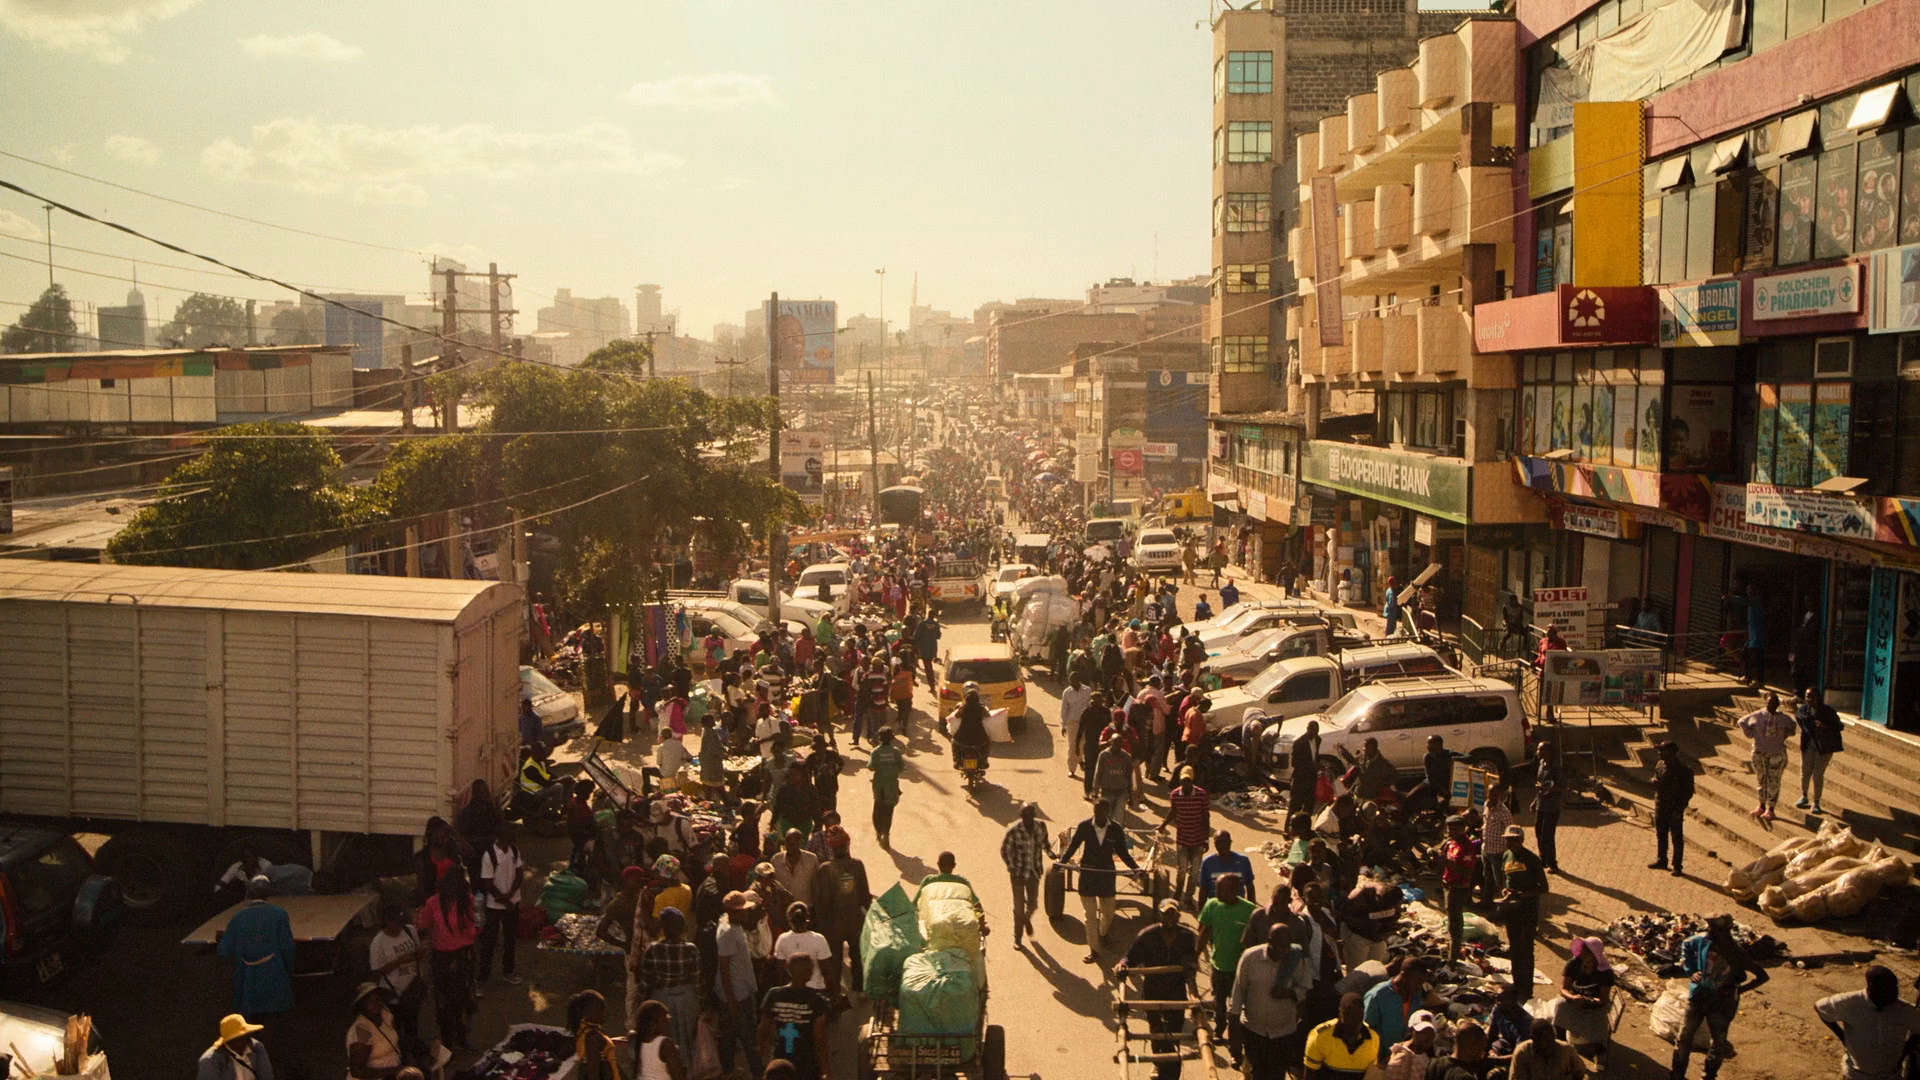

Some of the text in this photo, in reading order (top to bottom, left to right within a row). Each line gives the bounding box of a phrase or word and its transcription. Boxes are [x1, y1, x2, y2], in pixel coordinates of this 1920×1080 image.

[1777, 277, 1830, 293] GOLDCHEM
[1687, 286, 1735, 312] GUARDIAN
[1770, 289, 1836, 312] PHARMACY
[1400, 465, 1430, 497] BANK
[1748, 485, 1784, 494] LUCKYSTAR
[1712, 526, 1737, 539] GROUND
[1737, 530, 1758, 543] FLOOR
[1759, 535, 1777, 546] SHOP
[1535, 589, 1586, 602] TO LET
[1148, 609, 1157, 620] 91
